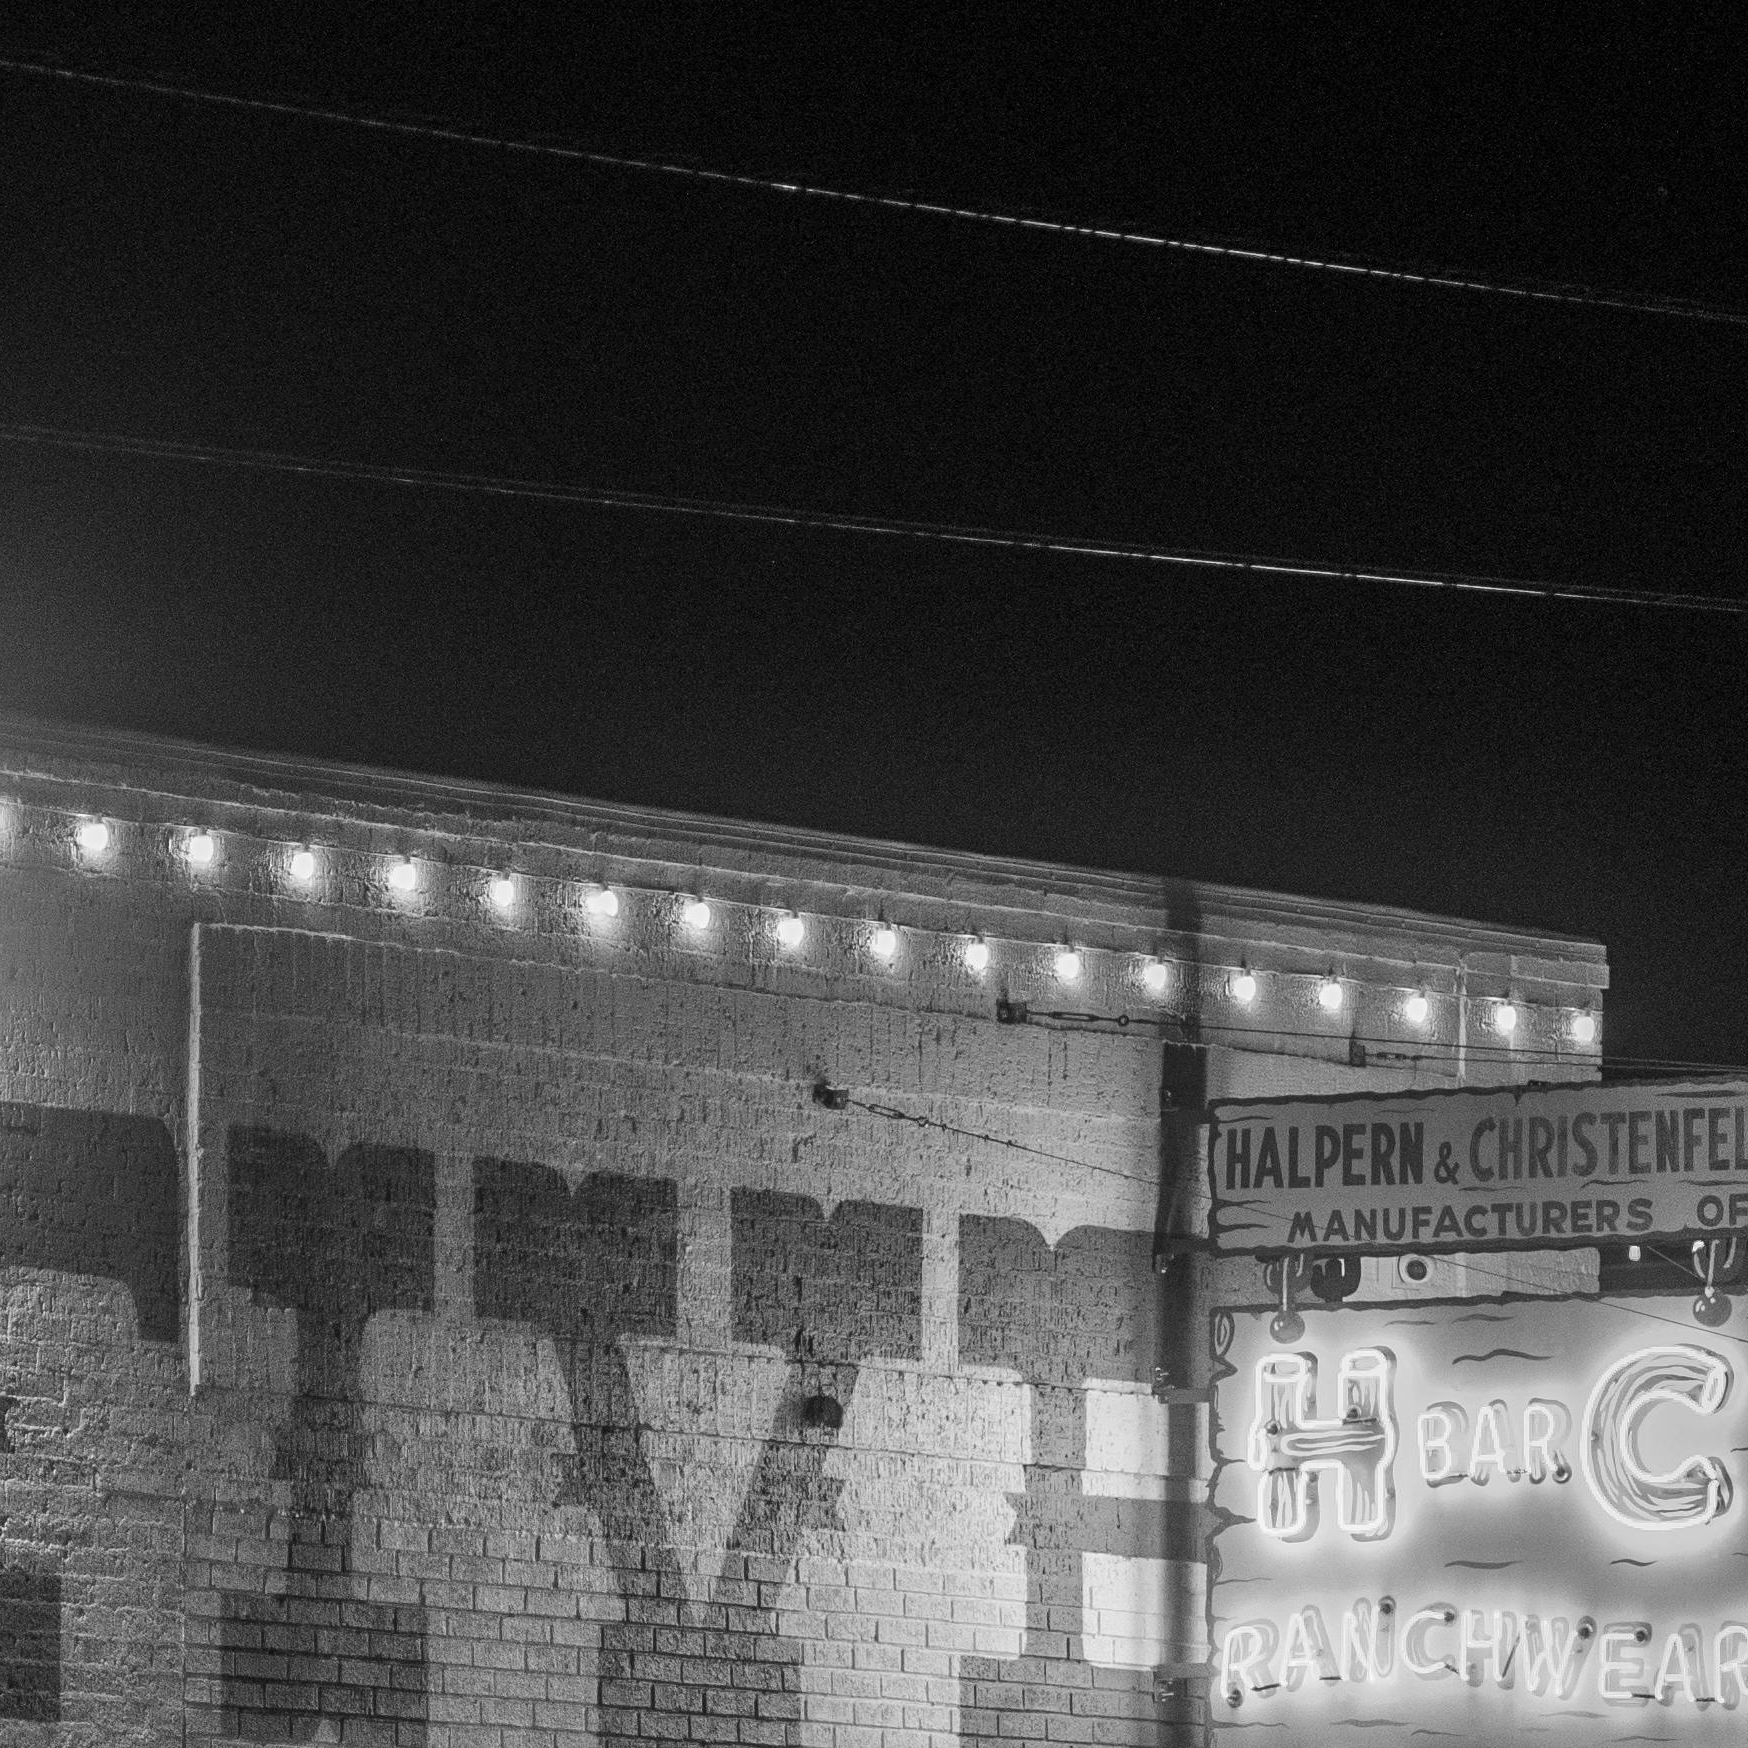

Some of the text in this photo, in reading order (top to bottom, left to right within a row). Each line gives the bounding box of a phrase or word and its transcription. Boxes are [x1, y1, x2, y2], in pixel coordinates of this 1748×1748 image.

[1225, 1121, 1425, 1191] HALPERN
[1433, 1141, 1459, 1185] &
[1287, 1197, 1654, 1243] MANUFACTURERS
[1248, 1342, 1735, 1542] H BAR C
